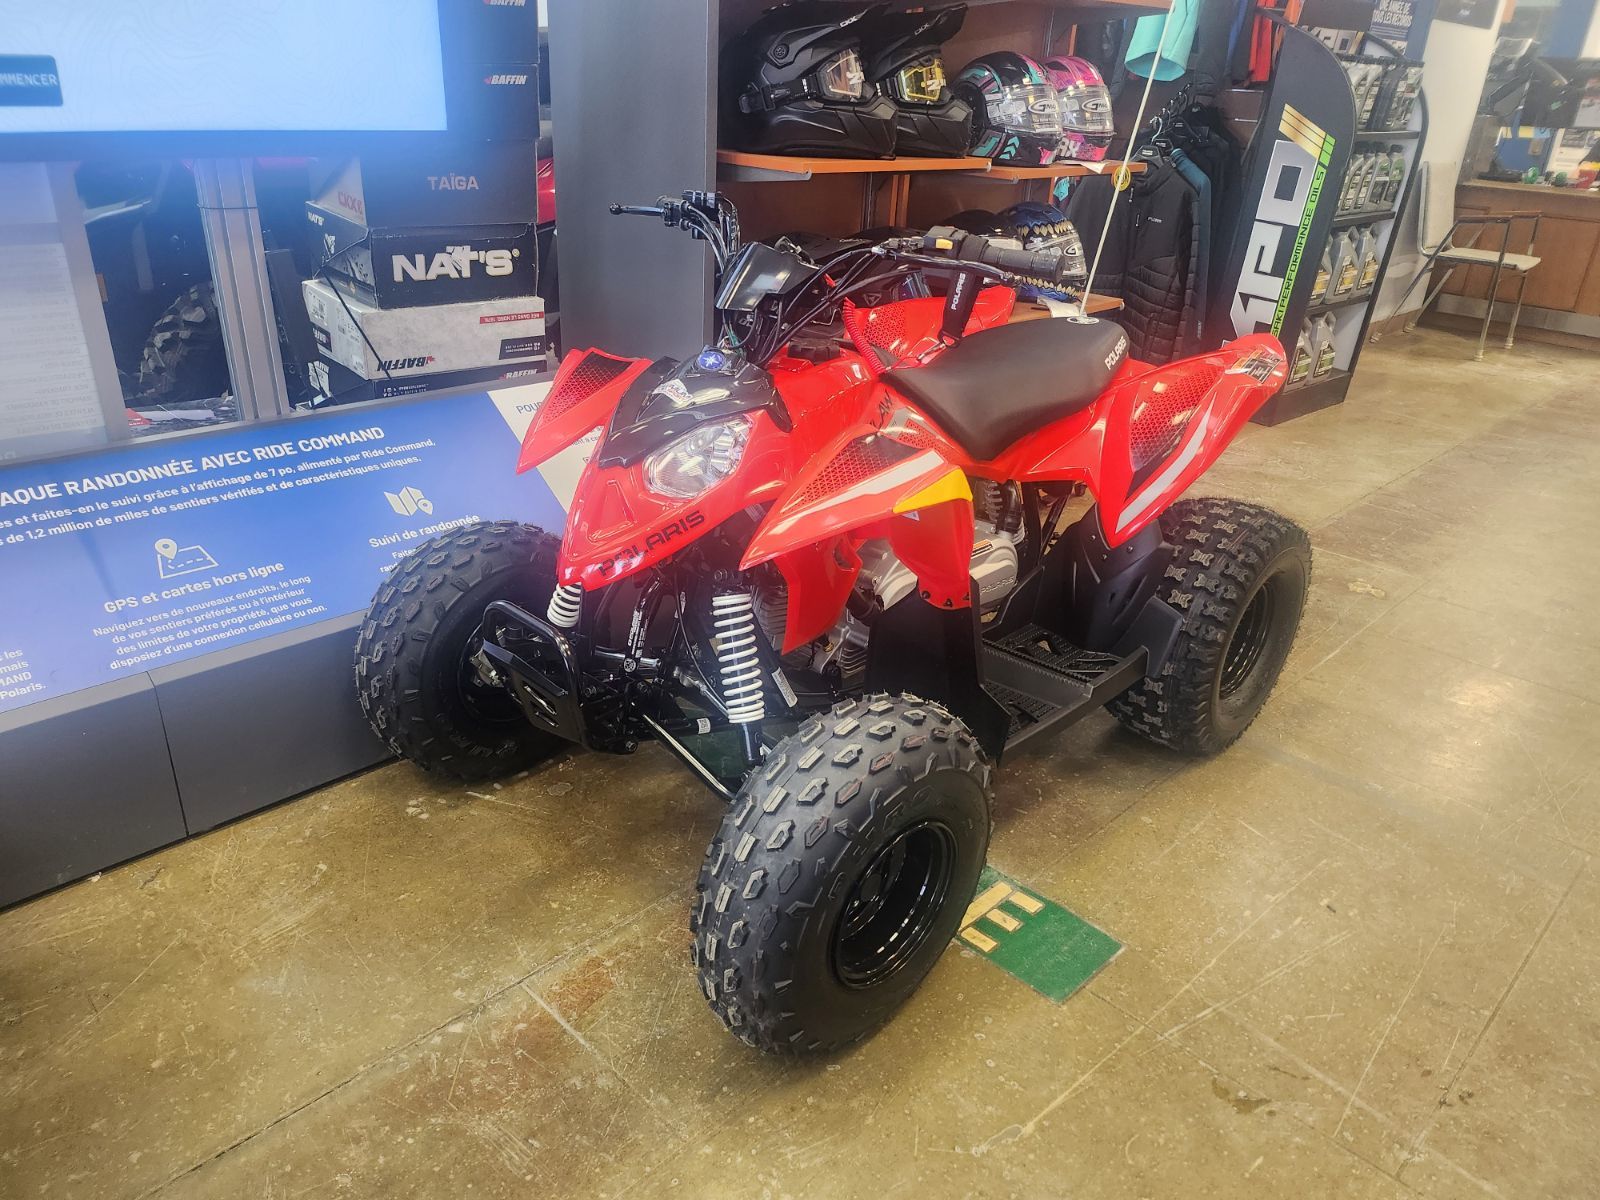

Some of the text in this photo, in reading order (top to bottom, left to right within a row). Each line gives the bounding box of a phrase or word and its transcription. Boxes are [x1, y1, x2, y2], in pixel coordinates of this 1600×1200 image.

[490, 74, 528, 85] BAFFIN
[427, 173, 479, 191] TAÏGA
[1279, 207, 1314, 308] PERFORMANCE
[1310, 169, 1326, 203] OILS
[950, 272, 966, 311] POLARIS
[377, 356, 427, 372] BAFFIN
[1104, 335, 1127, 371] POLARIS
[0, 426, 385, 507] AQUE RANDONNÉE AVEC RIDE COMMAND
[15, 515, 30, 526] et
[31, 504, 95, 523] faites-en
[97, 501, 110, 511] le
[110, 493, 142, 508] suivi
[143, 488, 179, 503] grâce
[181, 485, 190, 494] à
[253, 471, 269, 481] de
[268, 468, 276, 477] 7
[278, 466, 297, 476] po,
[297, 455, 343, 472] alimenté
[343, 453, 361, 464] par
[361, 448, 385, 460] Ride
[385, 438, 436, 455] Command,
[6, 534, 25, 545] de
[25, 528, 47, 540] 1,2
[48, 519, 94, 536] million
[95, 517, 113, 527] de
[114, 508, 150, 523] miles
[151, 503, 168, 516] de
[169, 493, 220, 512] sentiers
[219, 485, 265, 502] vérifiés
[265, 482, 279, 492] et
[279, 479, 294, 490] de
[295, 464, 380, 486] caractéristiques
[380, 455, 422, 472] uniques.
[368, 513, 481, 548] Suivi de randonnée
[597, 510, 705, 578] POLARIS
[93, 575, 312, 637] Naviguez vers de nouveaux endroits, le long
[104, 562, 285, 613] GPS et cartes hors ligne
[110, 603, 328, 670] disposiez d'une connexion cellulaire ou non.
[112, 635, 127, 644] de
[127, 630, 149, 640] vos
[149, 618, 193, 634] sentiers
[194, 604, 238, 624] préférés
[238, 602, 252, 611] ou
[116, 596, 313, 656] des limites de votre propriété, que vous
[3, 648, 24, 660] les
